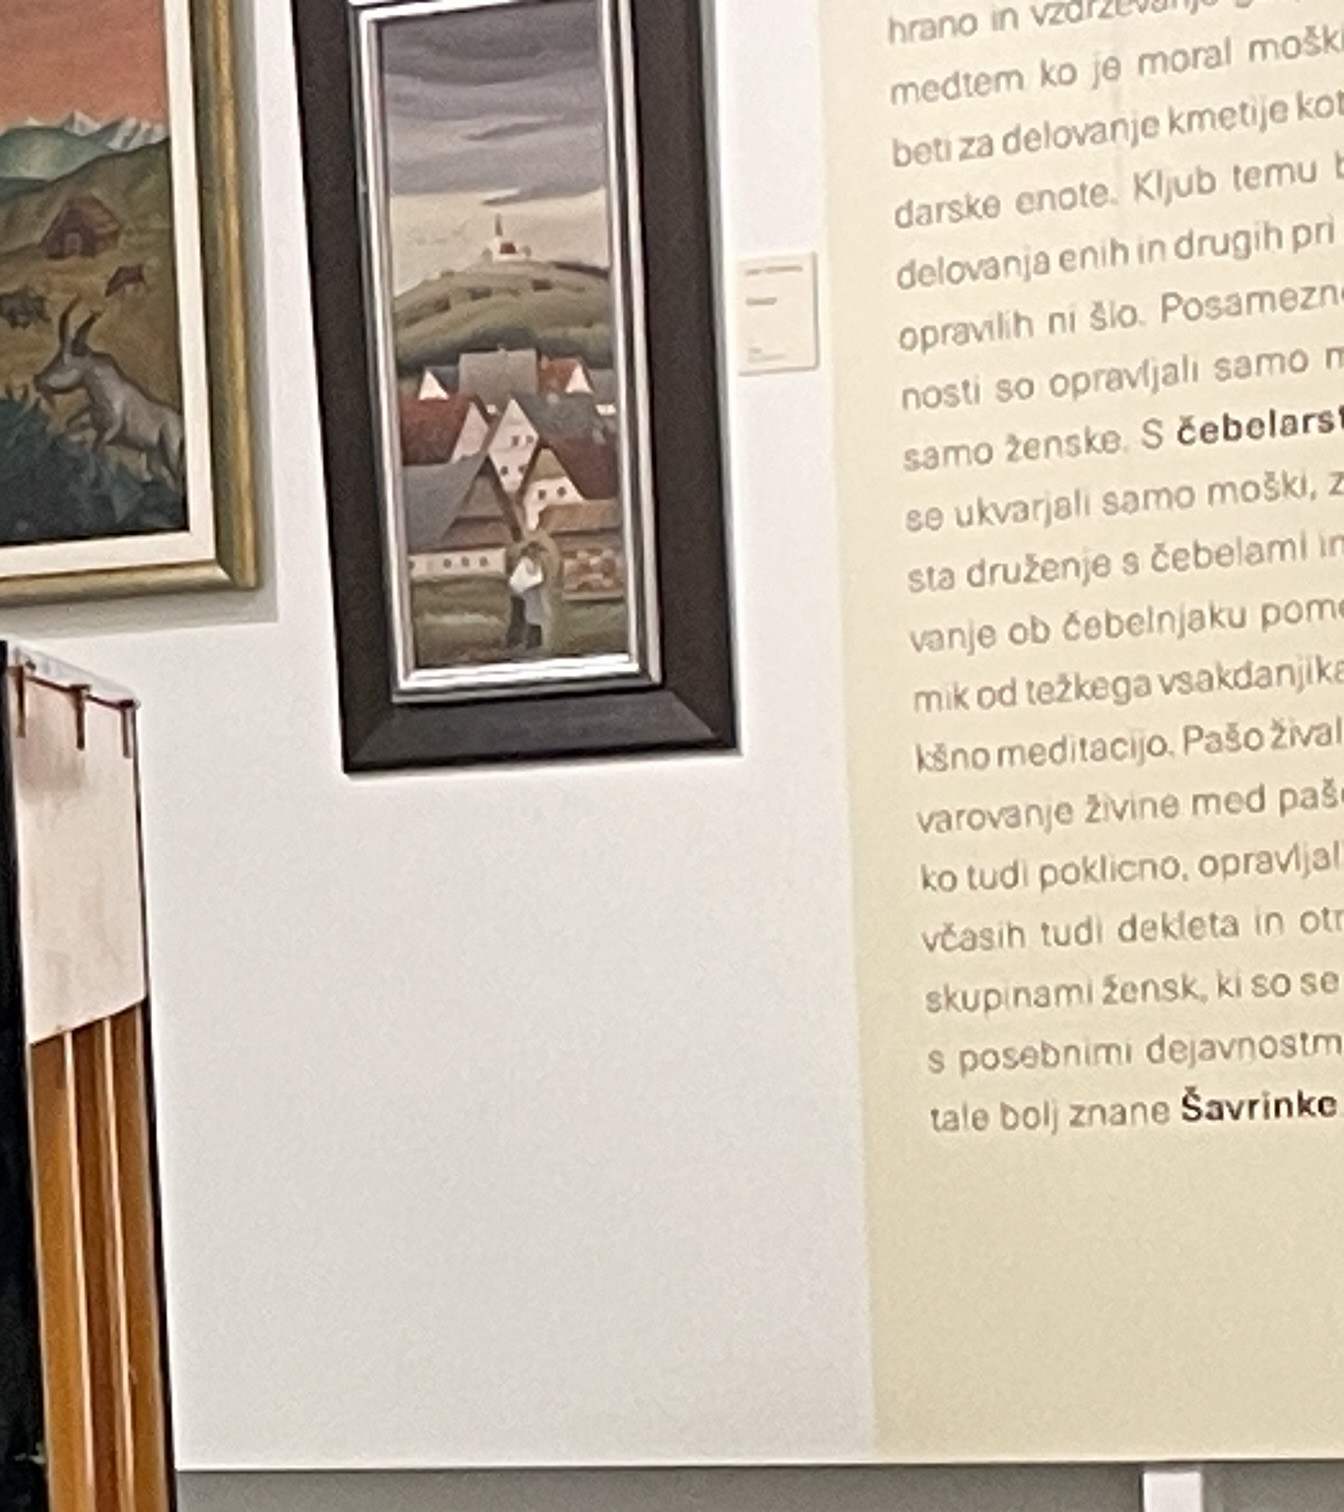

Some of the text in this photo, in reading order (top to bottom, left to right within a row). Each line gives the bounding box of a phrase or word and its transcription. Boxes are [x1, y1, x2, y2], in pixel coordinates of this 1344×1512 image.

[888, 13, 978, 44] hrano
[991, 7, 1019, 32] in
[890, 69, 1024, 105] medtem
[1040, 57, 1078, 87] ko
[1092, 52, 1122, 90] je
[1138, 35, 1231, 75] moral
[893, 137, 952, 167] beti
[959, 133, 994, 161] za
[1002, 108, 1160, 156] delovanje
[1169, 95, 1289, 136] kmetije
[895, 192, 1001, 229] darske
[1133, 165, 1216, 207] Kljub
[1233, 160, 1317, 192] temu
[897, 213, 1334, 290] delovanja enih in drugih pri
[899, 310, 1034, 357] opravilih
[1049, 301, 1076, 335] ni
[1162, 283, 1344, 323] Posamezn
[902, 373, 980, 411] nosti
[995, 377, 1035, 403] so
[1049, 353, 1198, 401] opravljali
[1214, 349, 1309, 383] samo
[903, 441, 993, 473] samo
[1142, 417, 1163, 450] S
[906, 506, 944, 532] se
[955, 488, 1090, 528] ukvarjali
[1103, 484, 1195, 516] samo
[1208, 469, 1316, 506] moški,
[908, 566, 955, 593] sta
[967, 547, 1111, 587] druženje
[1122, 551, 1140, 576] s
[1151, 529, 1307, 573] čebelami
[910, 617, 996, 657] vanje
[1008, 614, 1051, 645] ob
[1063, 600, 1247, 641] čebelnjaku
[914, 681, 970, 713] mik
[977, 676, 1017, 711] od
[1026, 672, 1152, 706] težkega
[916, 742, 991, 774] kšno
[1183, 721, 1263, 756] Pašo
[915, 776, 1344, 835] varovanje živine med paš
[920, 864, 958, 893] ko
[967, 859, 1029, 890] tudi
[921, 920, 1025, 953] včasih
[1041, 912, 1103, 947] tudi
[1118, 909, 1239, 943] dekleta
[1255, 905, 1283, 937] in
[925, 978, 1094, 1020] skupinami
[1216, 968, 1242, 998] ki
[1251, 972, 1291, 998] so
[1300, 971, 1340, 996] se
[928, 1049, 945, 1074] s
[959, 1039, 1134, 1080] posebnimi
[931, 1085, 1338, 1136] tale bolj znane Šavrinke
